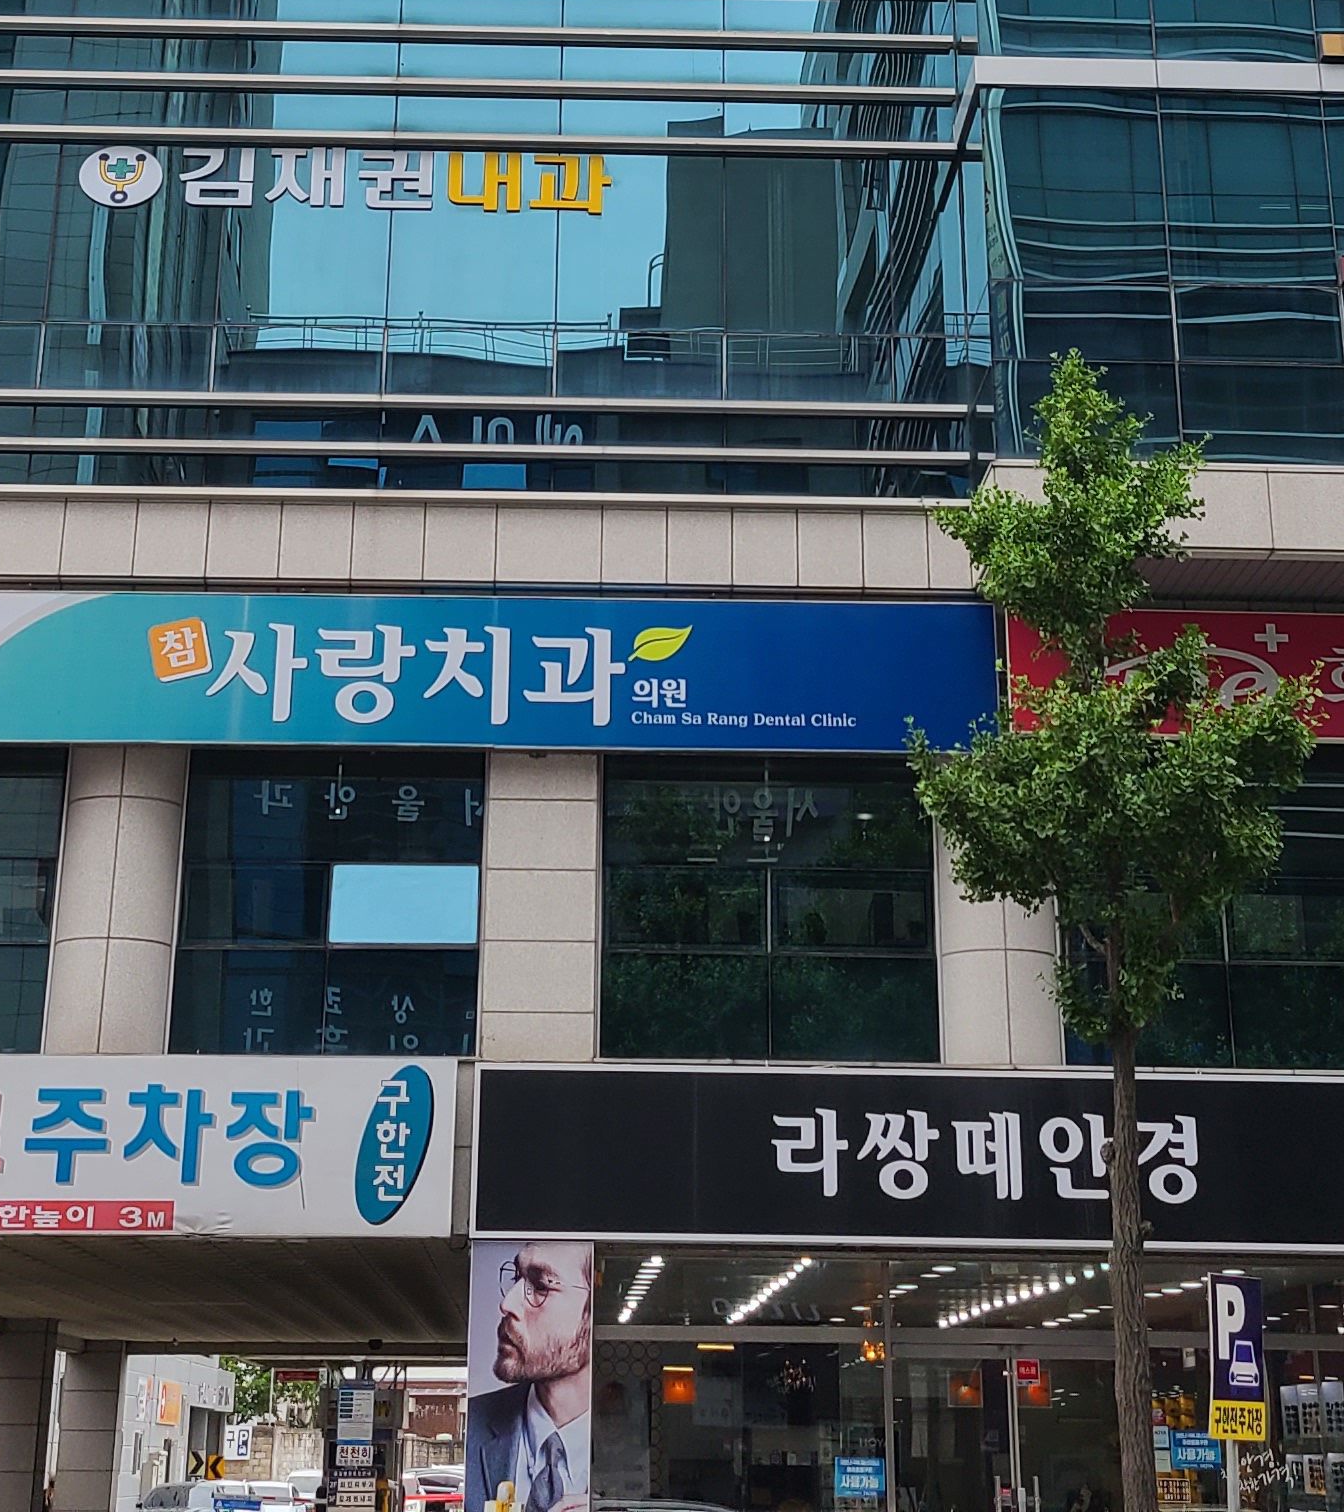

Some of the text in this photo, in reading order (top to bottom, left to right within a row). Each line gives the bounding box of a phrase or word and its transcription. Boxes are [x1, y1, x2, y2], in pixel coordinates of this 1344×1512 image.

[631, 677, 687, 709] 의원
[631, 711, 857, 728] Cham Sa Rang Dental Clinic
[371, 1078, 413, 1204] 구한전
[770, 1107, 1201, 1206] 라쌍떼안경
[1213, 1405, 1264, 1437] 구한전주차장
